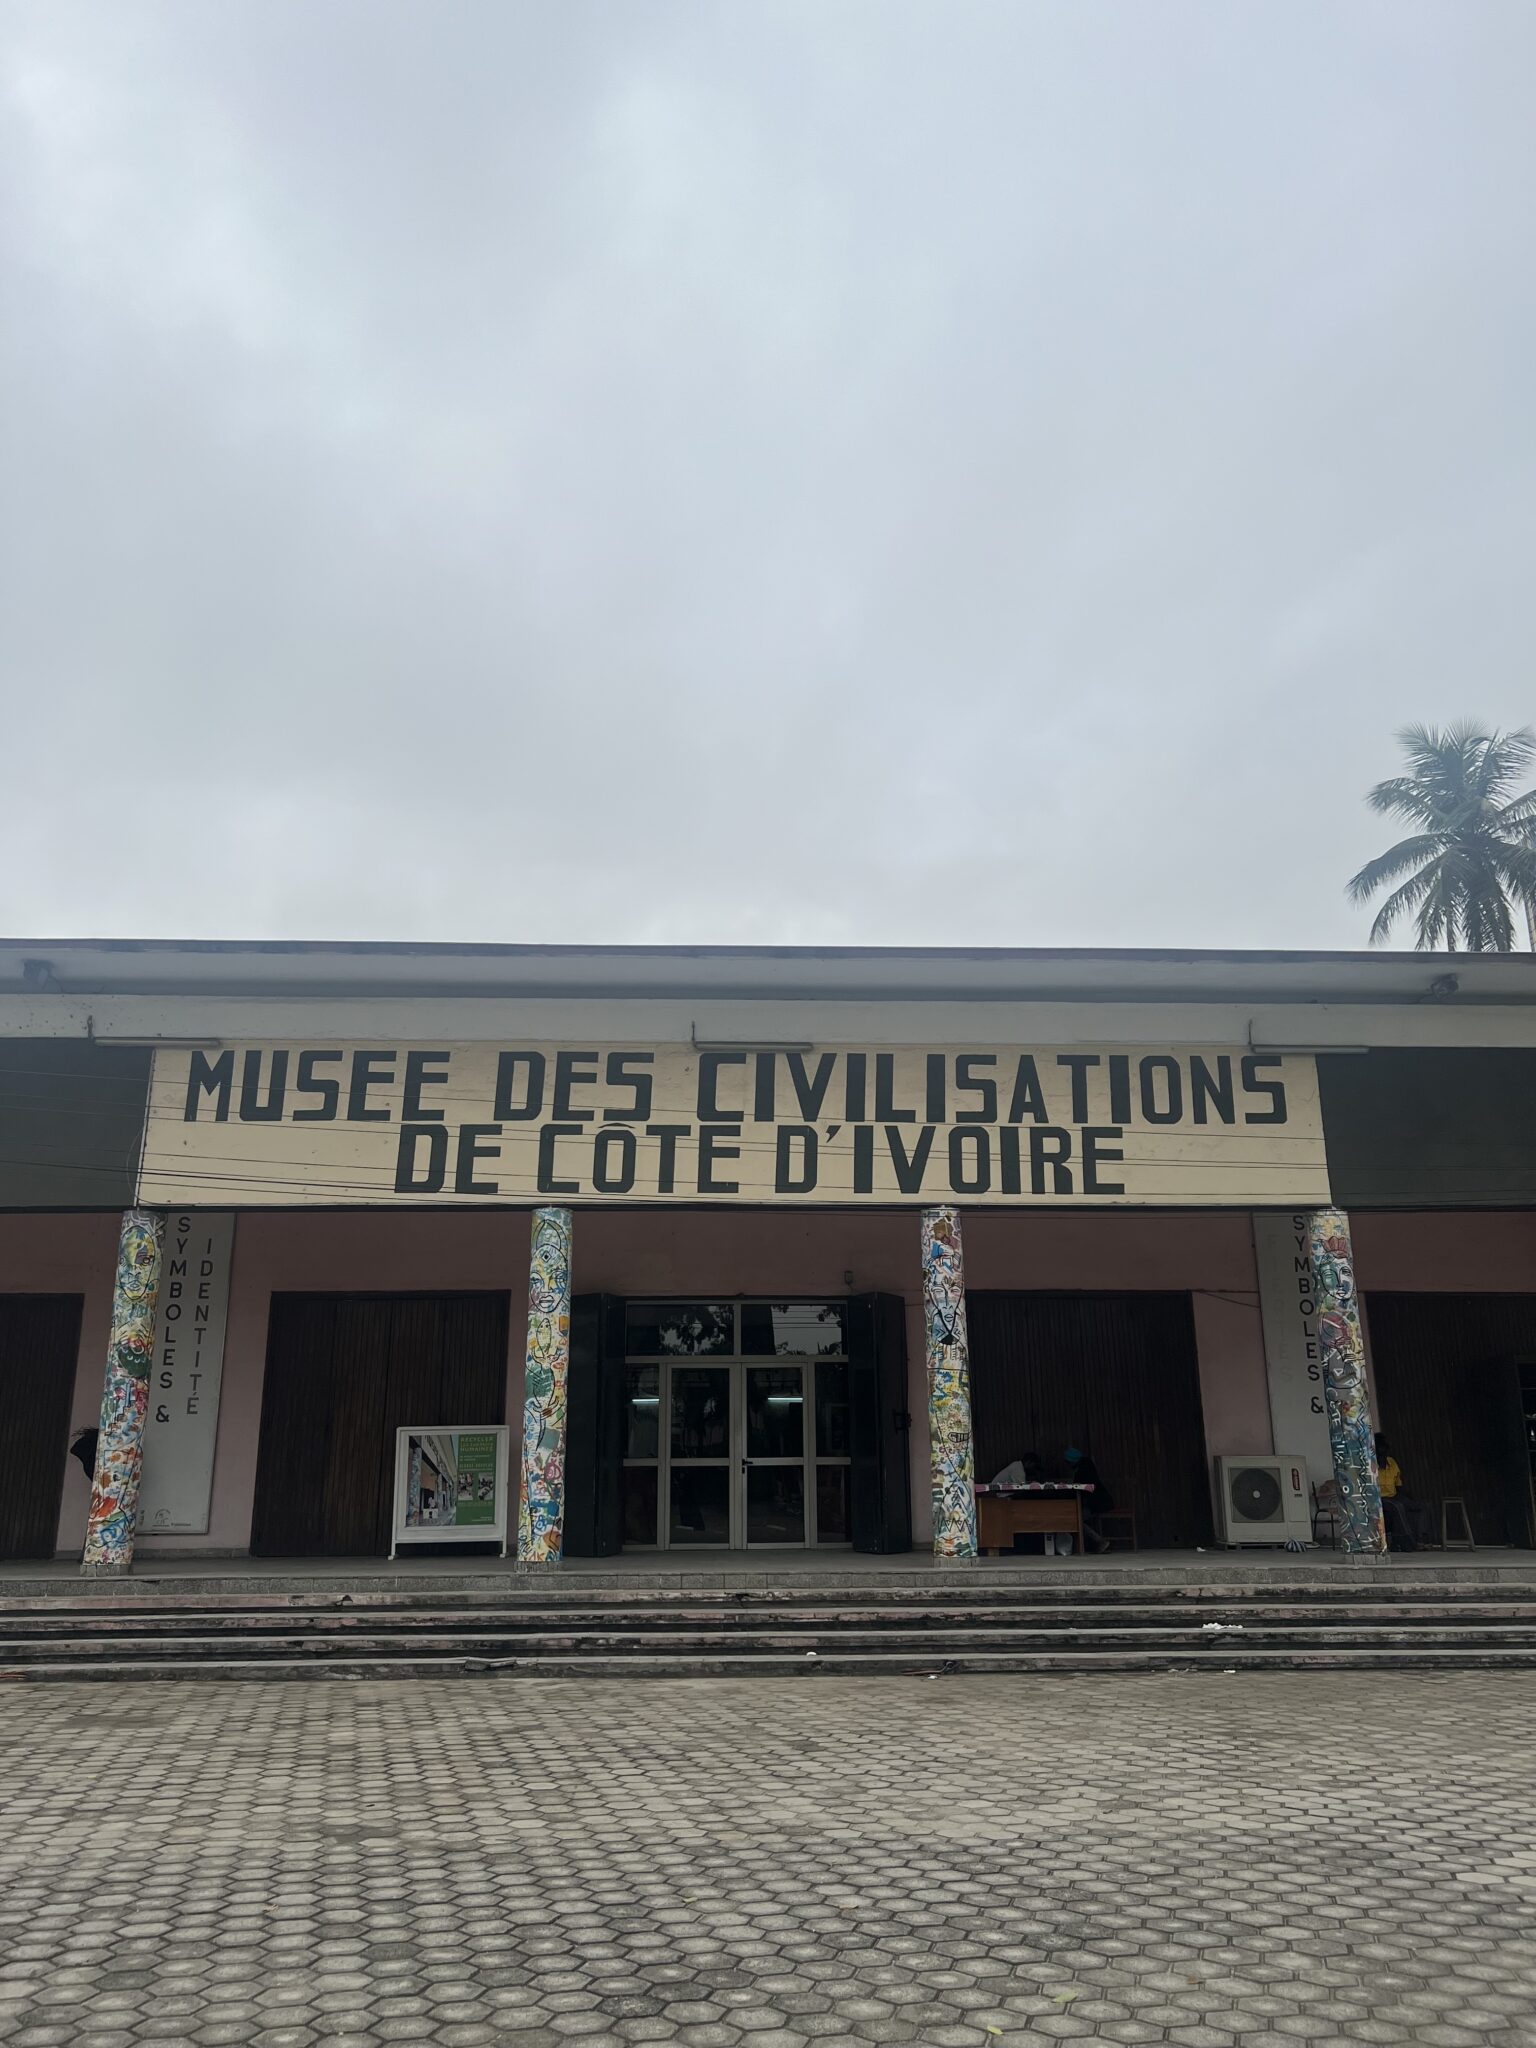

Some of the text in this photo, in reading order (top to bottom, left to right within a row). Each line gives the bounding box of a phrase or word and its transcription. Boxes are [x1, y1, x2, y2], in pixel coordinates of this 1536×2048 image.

[184, 1050, 1287, 1124] MUSEE DES CIVILISATIONS
[394, 1122, 1126, 1195] DE CÔTE D'IVOIRE
[155, 1217, 191, 1423] SYMBOLES &
[186, 1238, 214, 1415] IDENTITÉ
[1293, 1215, 1325, 1414] SYMBOLES &
